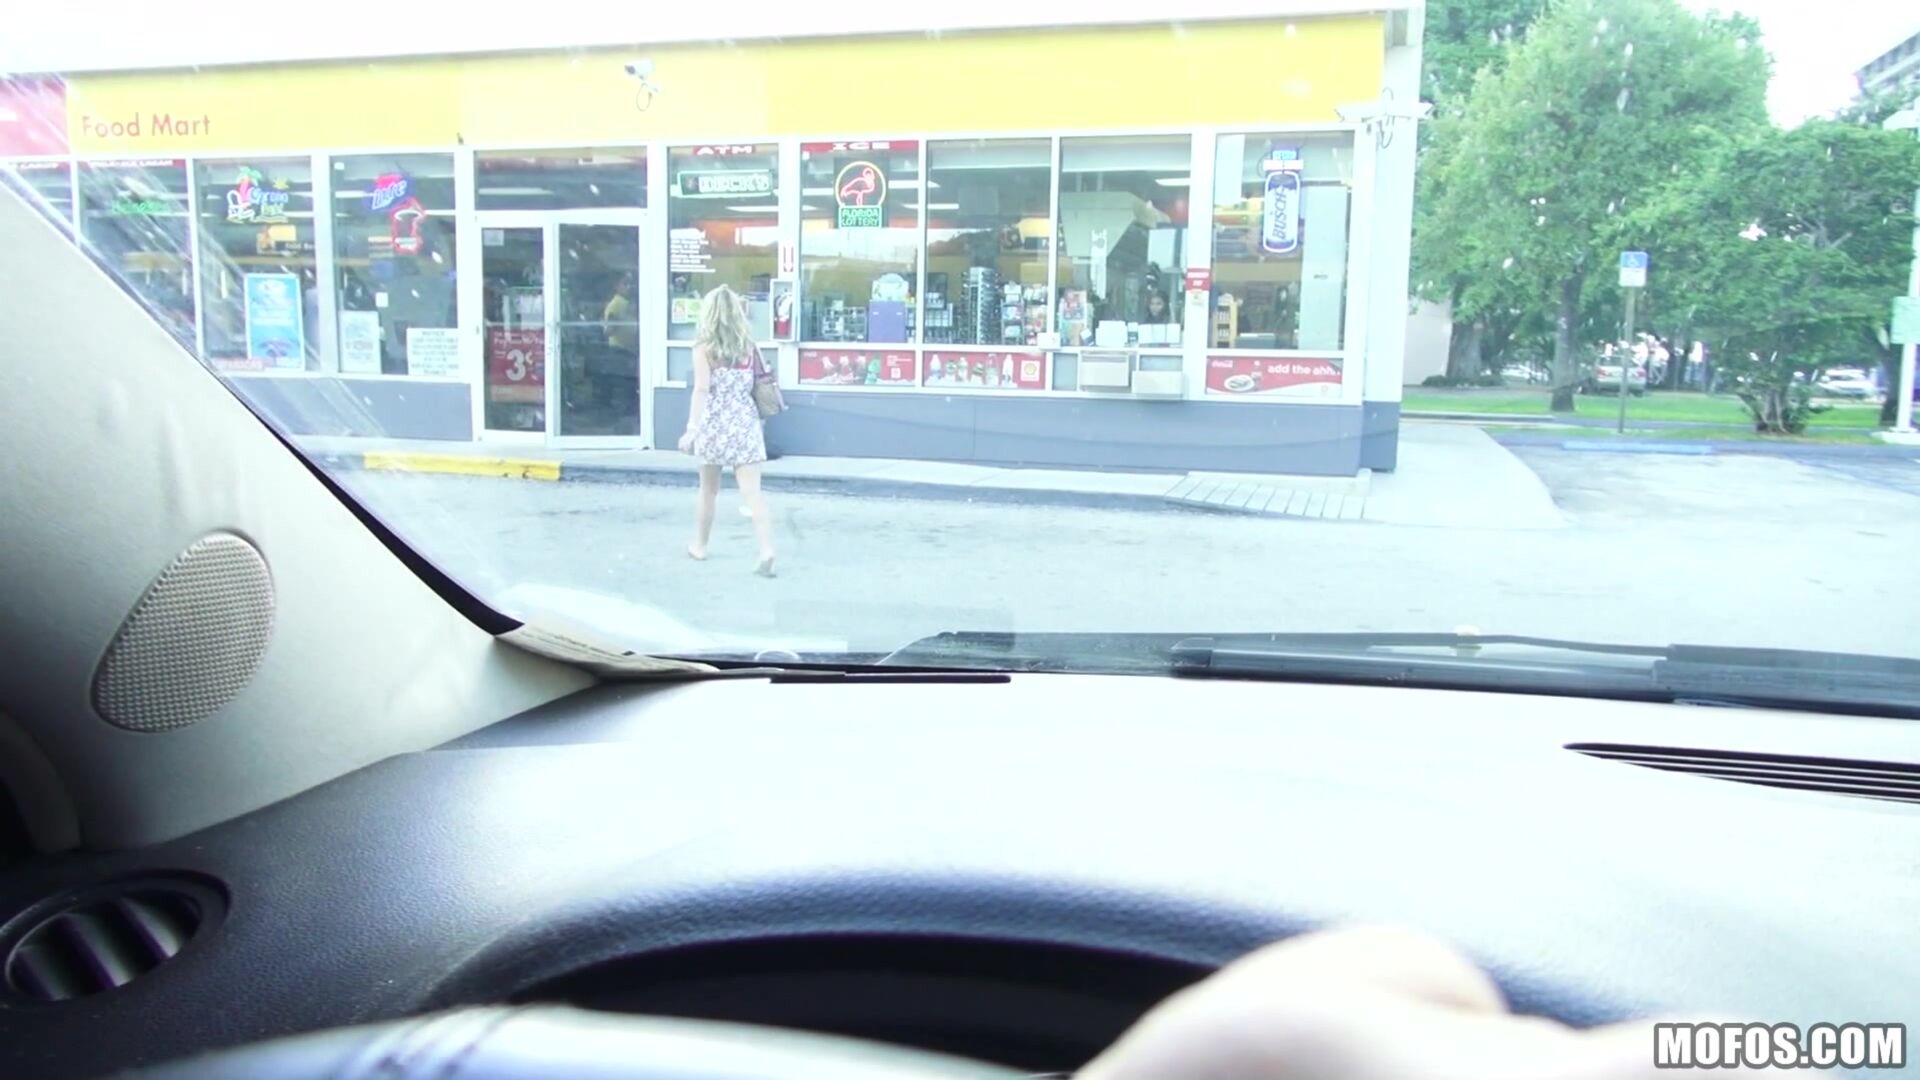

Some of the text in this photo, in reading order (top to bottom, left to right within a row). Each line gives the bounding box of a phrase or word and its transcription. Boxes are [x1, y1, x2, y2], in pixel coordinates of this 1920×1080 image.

[82, 112, 210, 138] Food Mart
[697, 146, 752, 155] ATM
[832, 142, 890, 151] ICE
[842, 207, 879, 217] FLORIDA
[1272, 188, 1287, 240] BUSCH
[842, 216, 879, 226] LOTTERY
[1267, 364, 1289, 374] add
[1292, 364, 1311, 375] the
